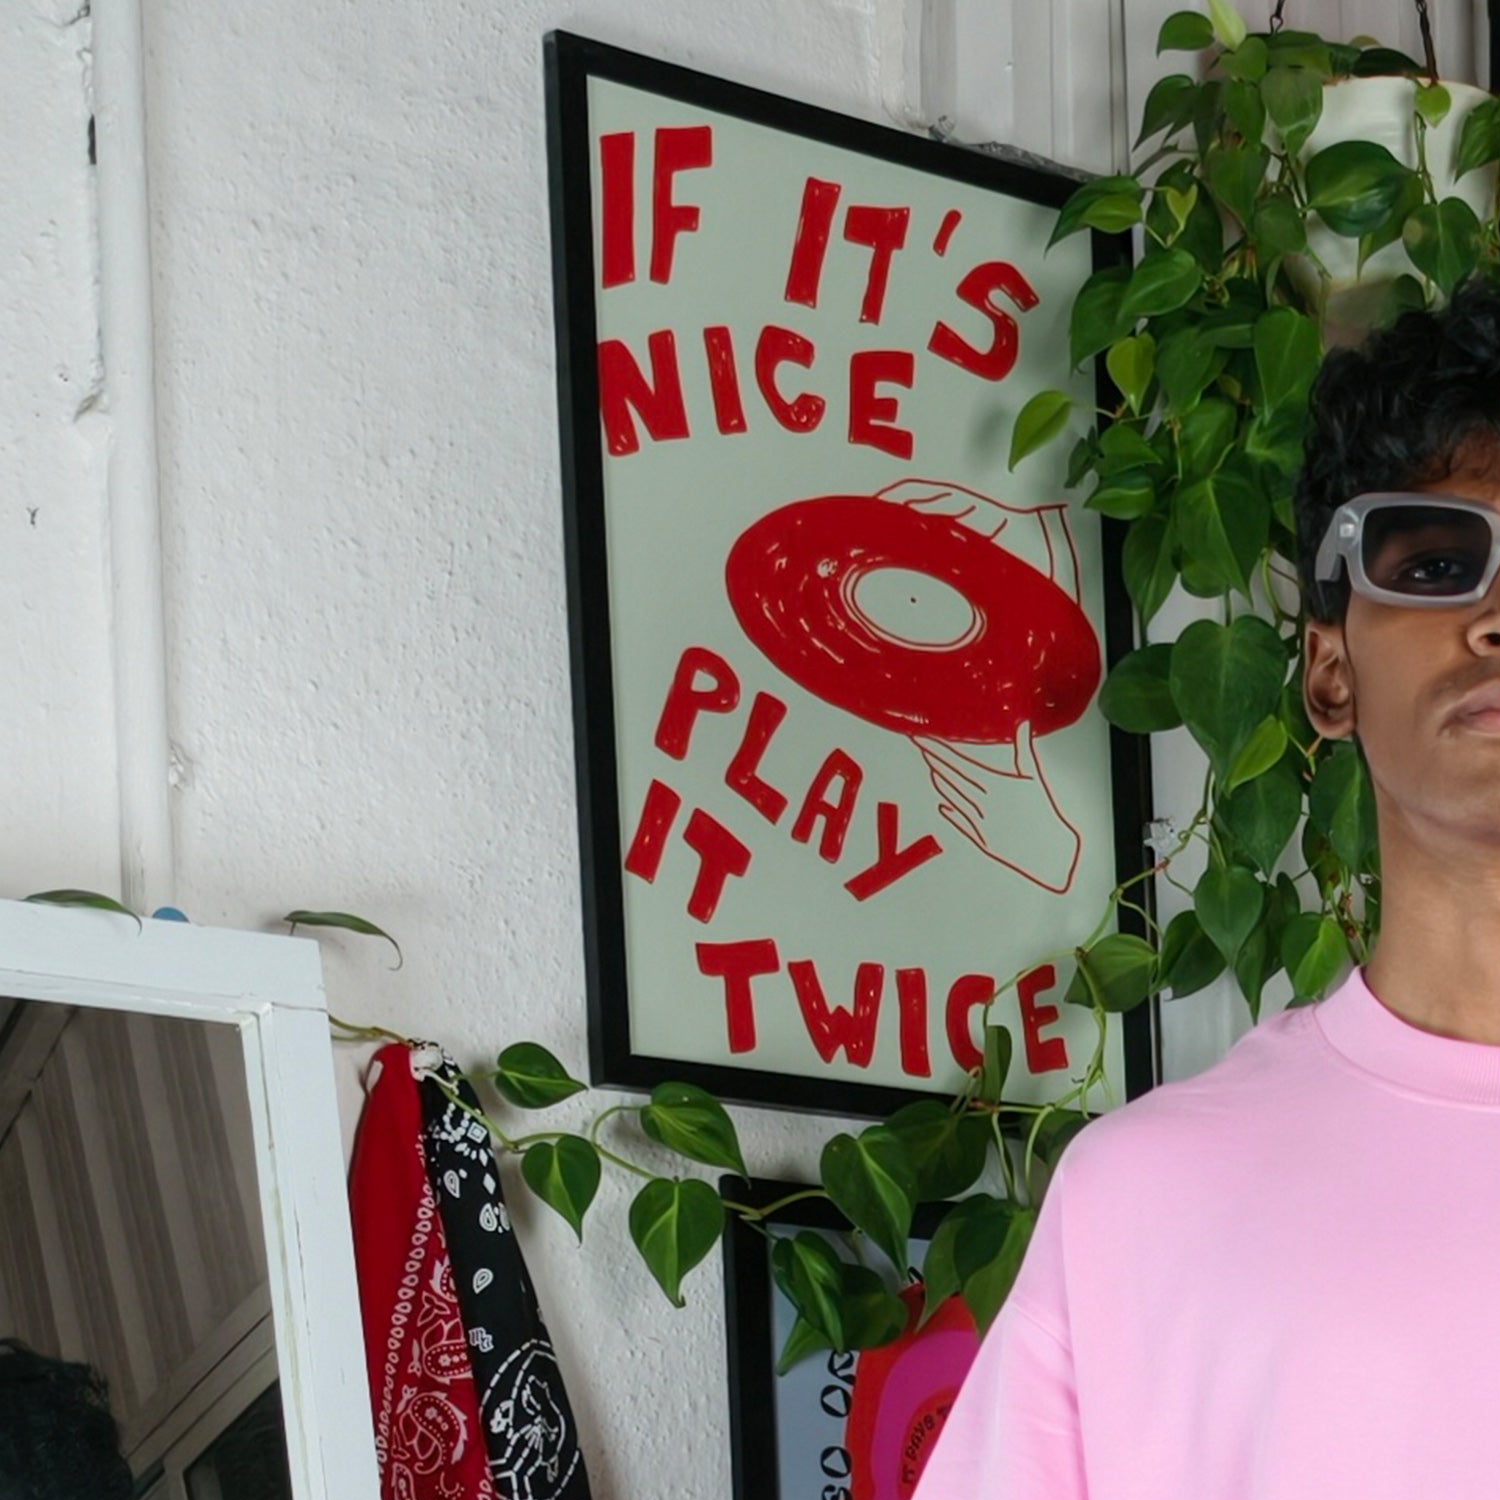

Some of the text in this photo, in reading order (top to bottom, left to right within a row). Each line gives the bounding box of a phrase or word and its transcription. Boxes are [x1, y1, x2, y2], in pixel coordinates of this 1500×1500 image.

[599, 125, 1040, 382] IF IT'S
[597, 324, 915, 461] NICE
[654, 645, 943, 902] PLAY
[624, 778, 752, 924] IT
[696, 938, 1069, 1078] TWICE
[820, 1350, 857, 1418] OR
